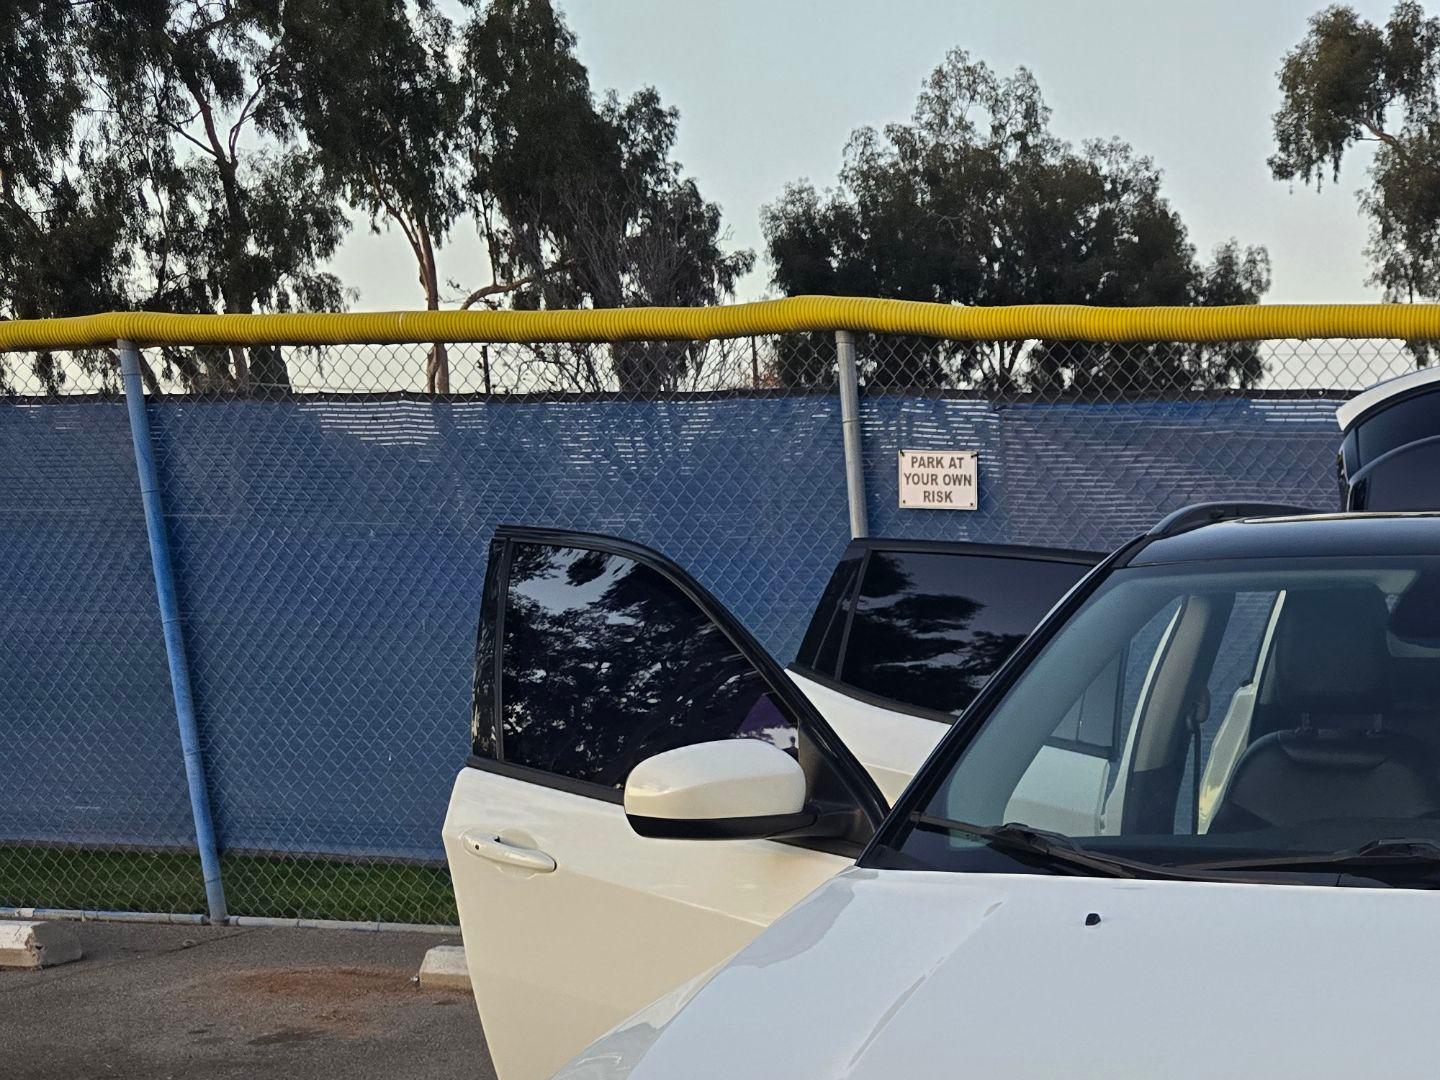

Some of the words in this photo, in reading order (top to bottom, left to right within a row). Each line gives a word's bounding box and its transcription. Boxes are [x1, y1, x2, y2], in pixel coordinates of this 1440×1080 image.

[911, 456, 945, 469] PARK
[948, 456, 965, 469] AT
[903, 472, 939, 486] YOUR
[942, 473, 972, 487] OWN
[923, 490, 953, 503] RISK
